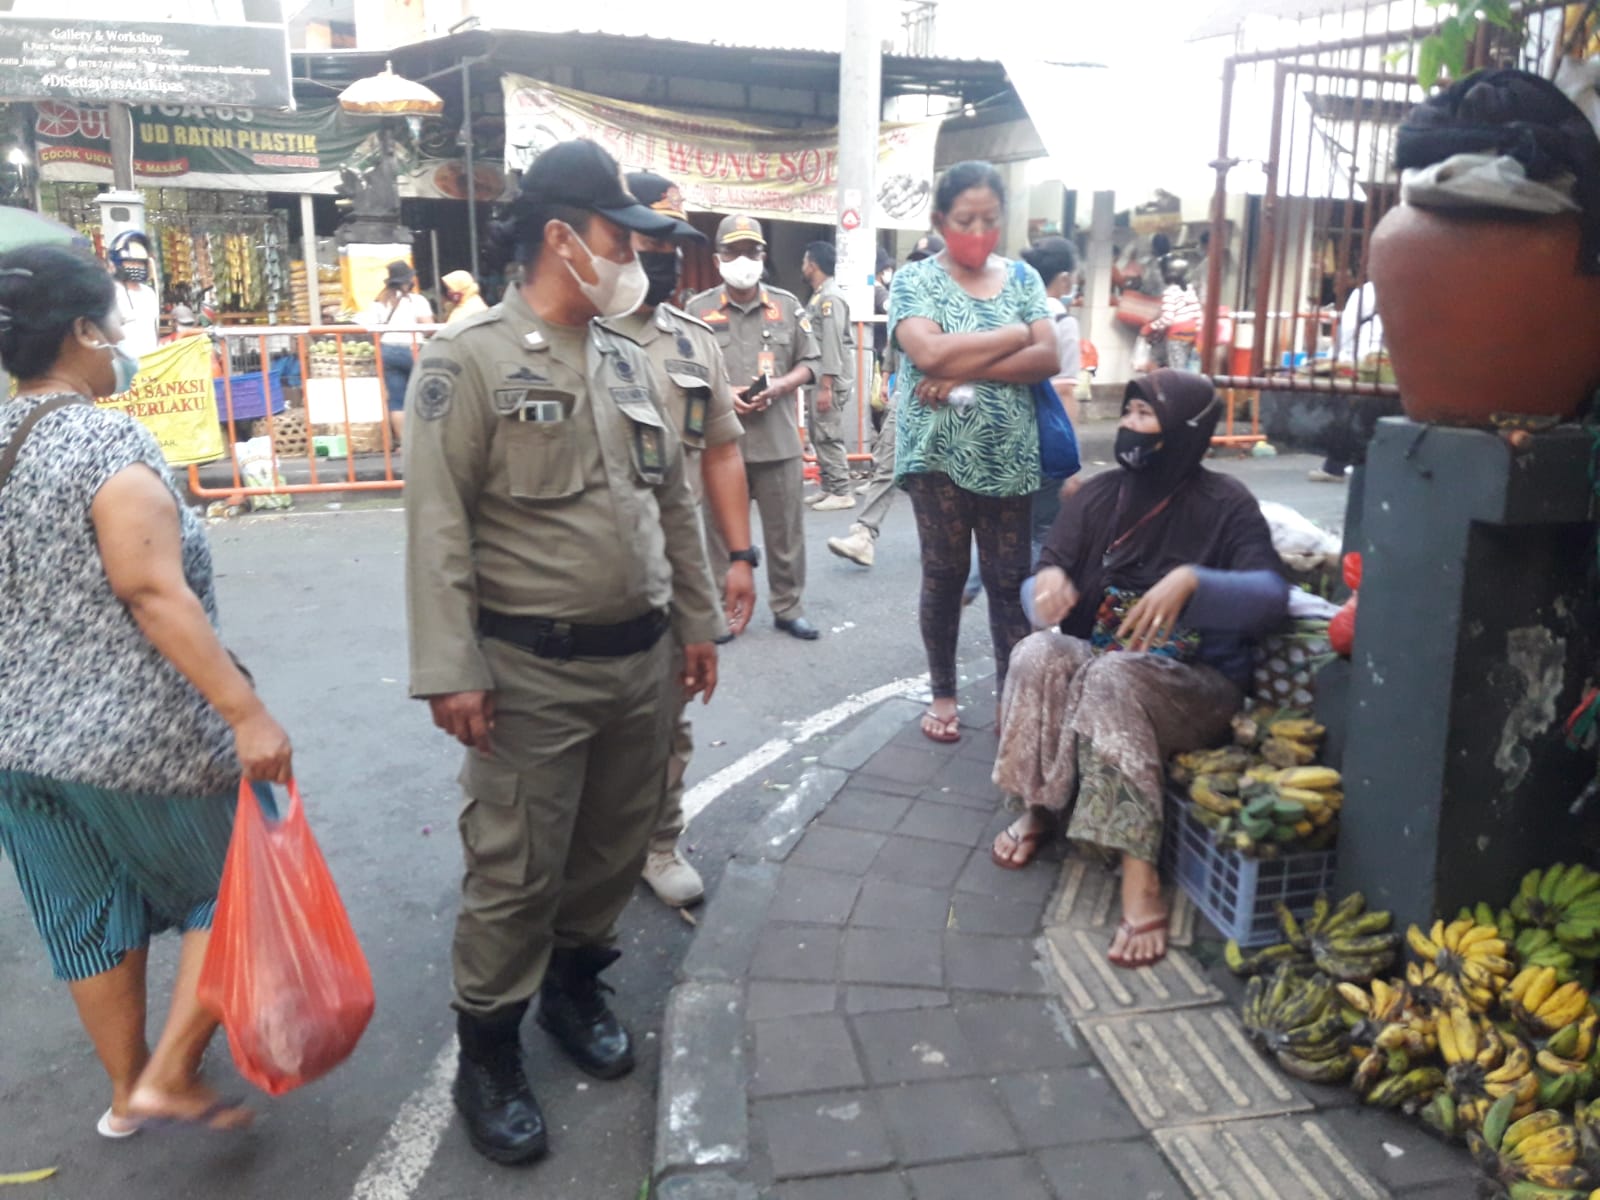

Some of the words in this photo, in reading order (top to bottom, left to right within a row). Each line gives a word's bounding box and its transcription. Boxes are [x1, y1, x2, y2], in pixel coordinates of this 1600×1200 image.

[51, 28, 93, 43] Gallery
[94, 30, 105, 41] &
[105, 30, 163, 46] Workshop
[139, 123, 170, 144] UD
[173, 124, 233, 149] RATNI
[237, 130, 319, 154] PLASTIK
[41, 150, 80, 161] COCOK
[667, 139, 770, 181] WONG
[776, 147, 839, 186] SOL
[144, 379, 205, 399] SANKSI
[125, 397, 206, 417] BERLAKU
